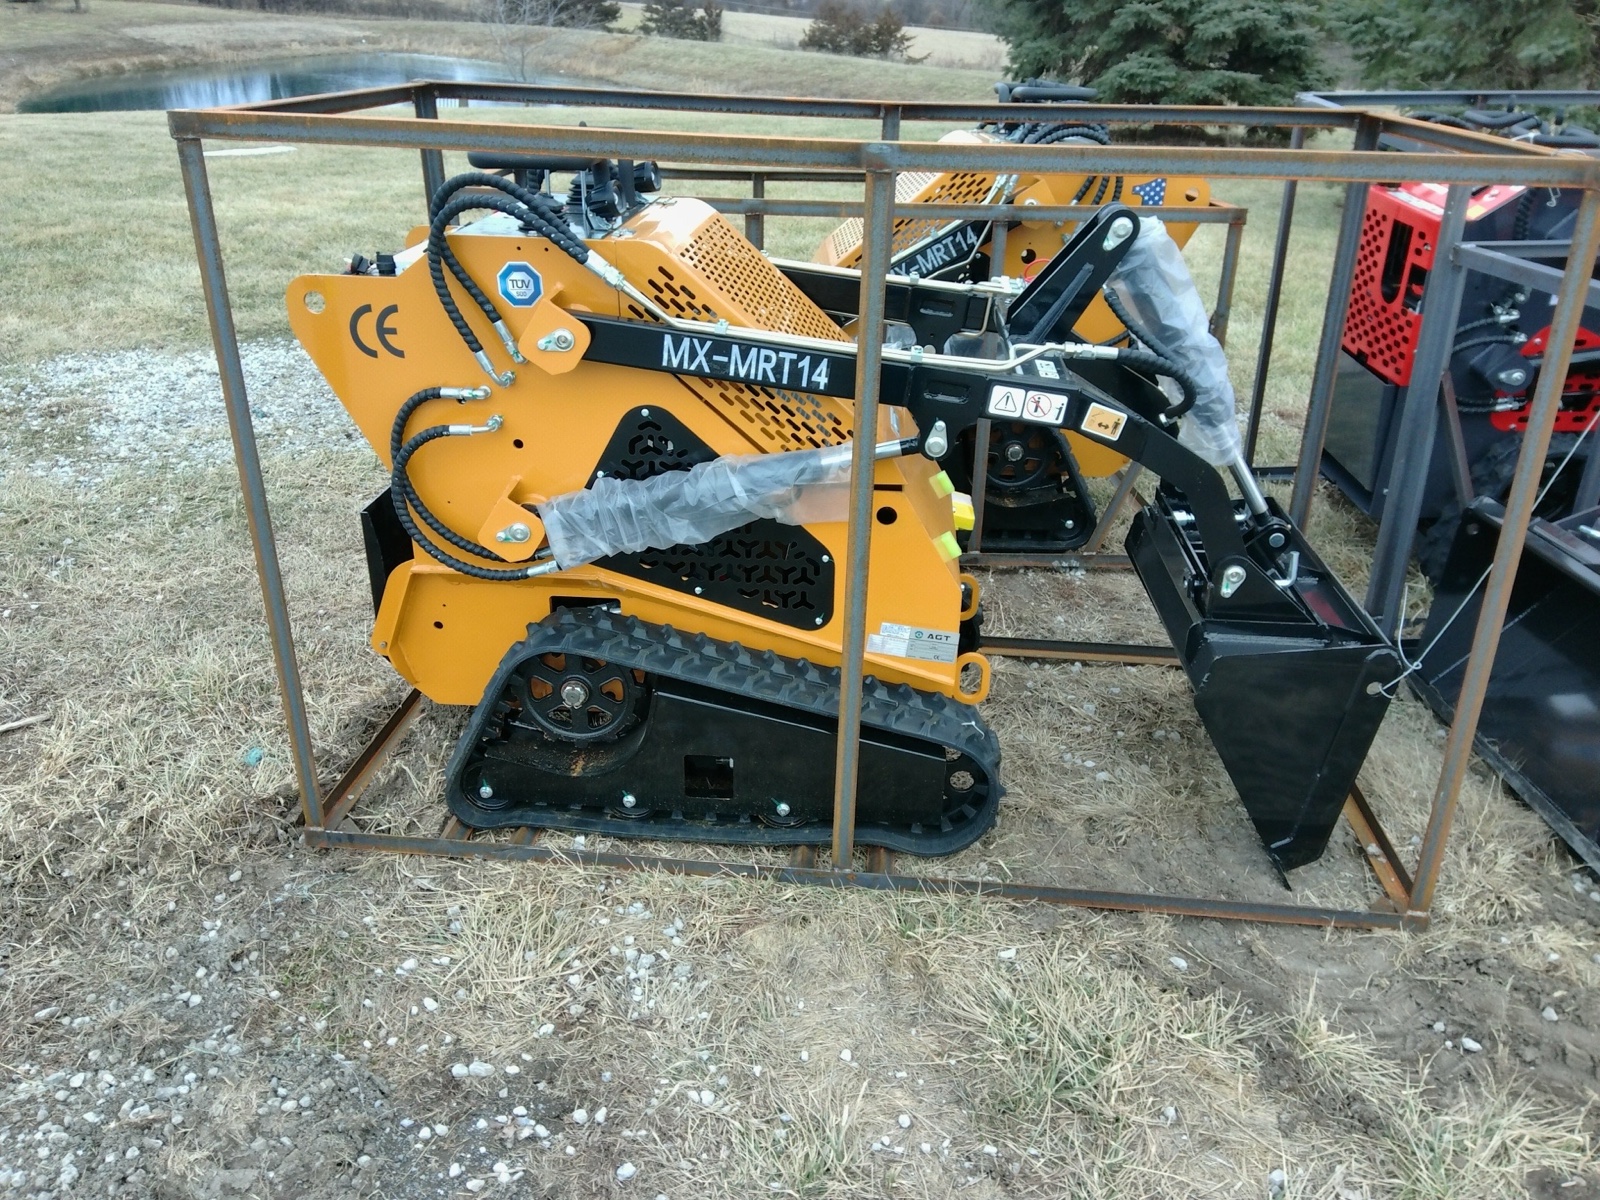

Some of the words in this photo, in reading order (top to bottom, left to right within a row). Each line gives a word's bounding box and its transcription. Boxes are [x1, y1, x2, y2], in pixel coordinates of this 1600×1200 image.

[509, 278, 531, 289] TÜV
[349, 304, 405, 359] CE
[661, 334, 829, 390] MX-MRT14
[927, 633, 951, 641] AGT
